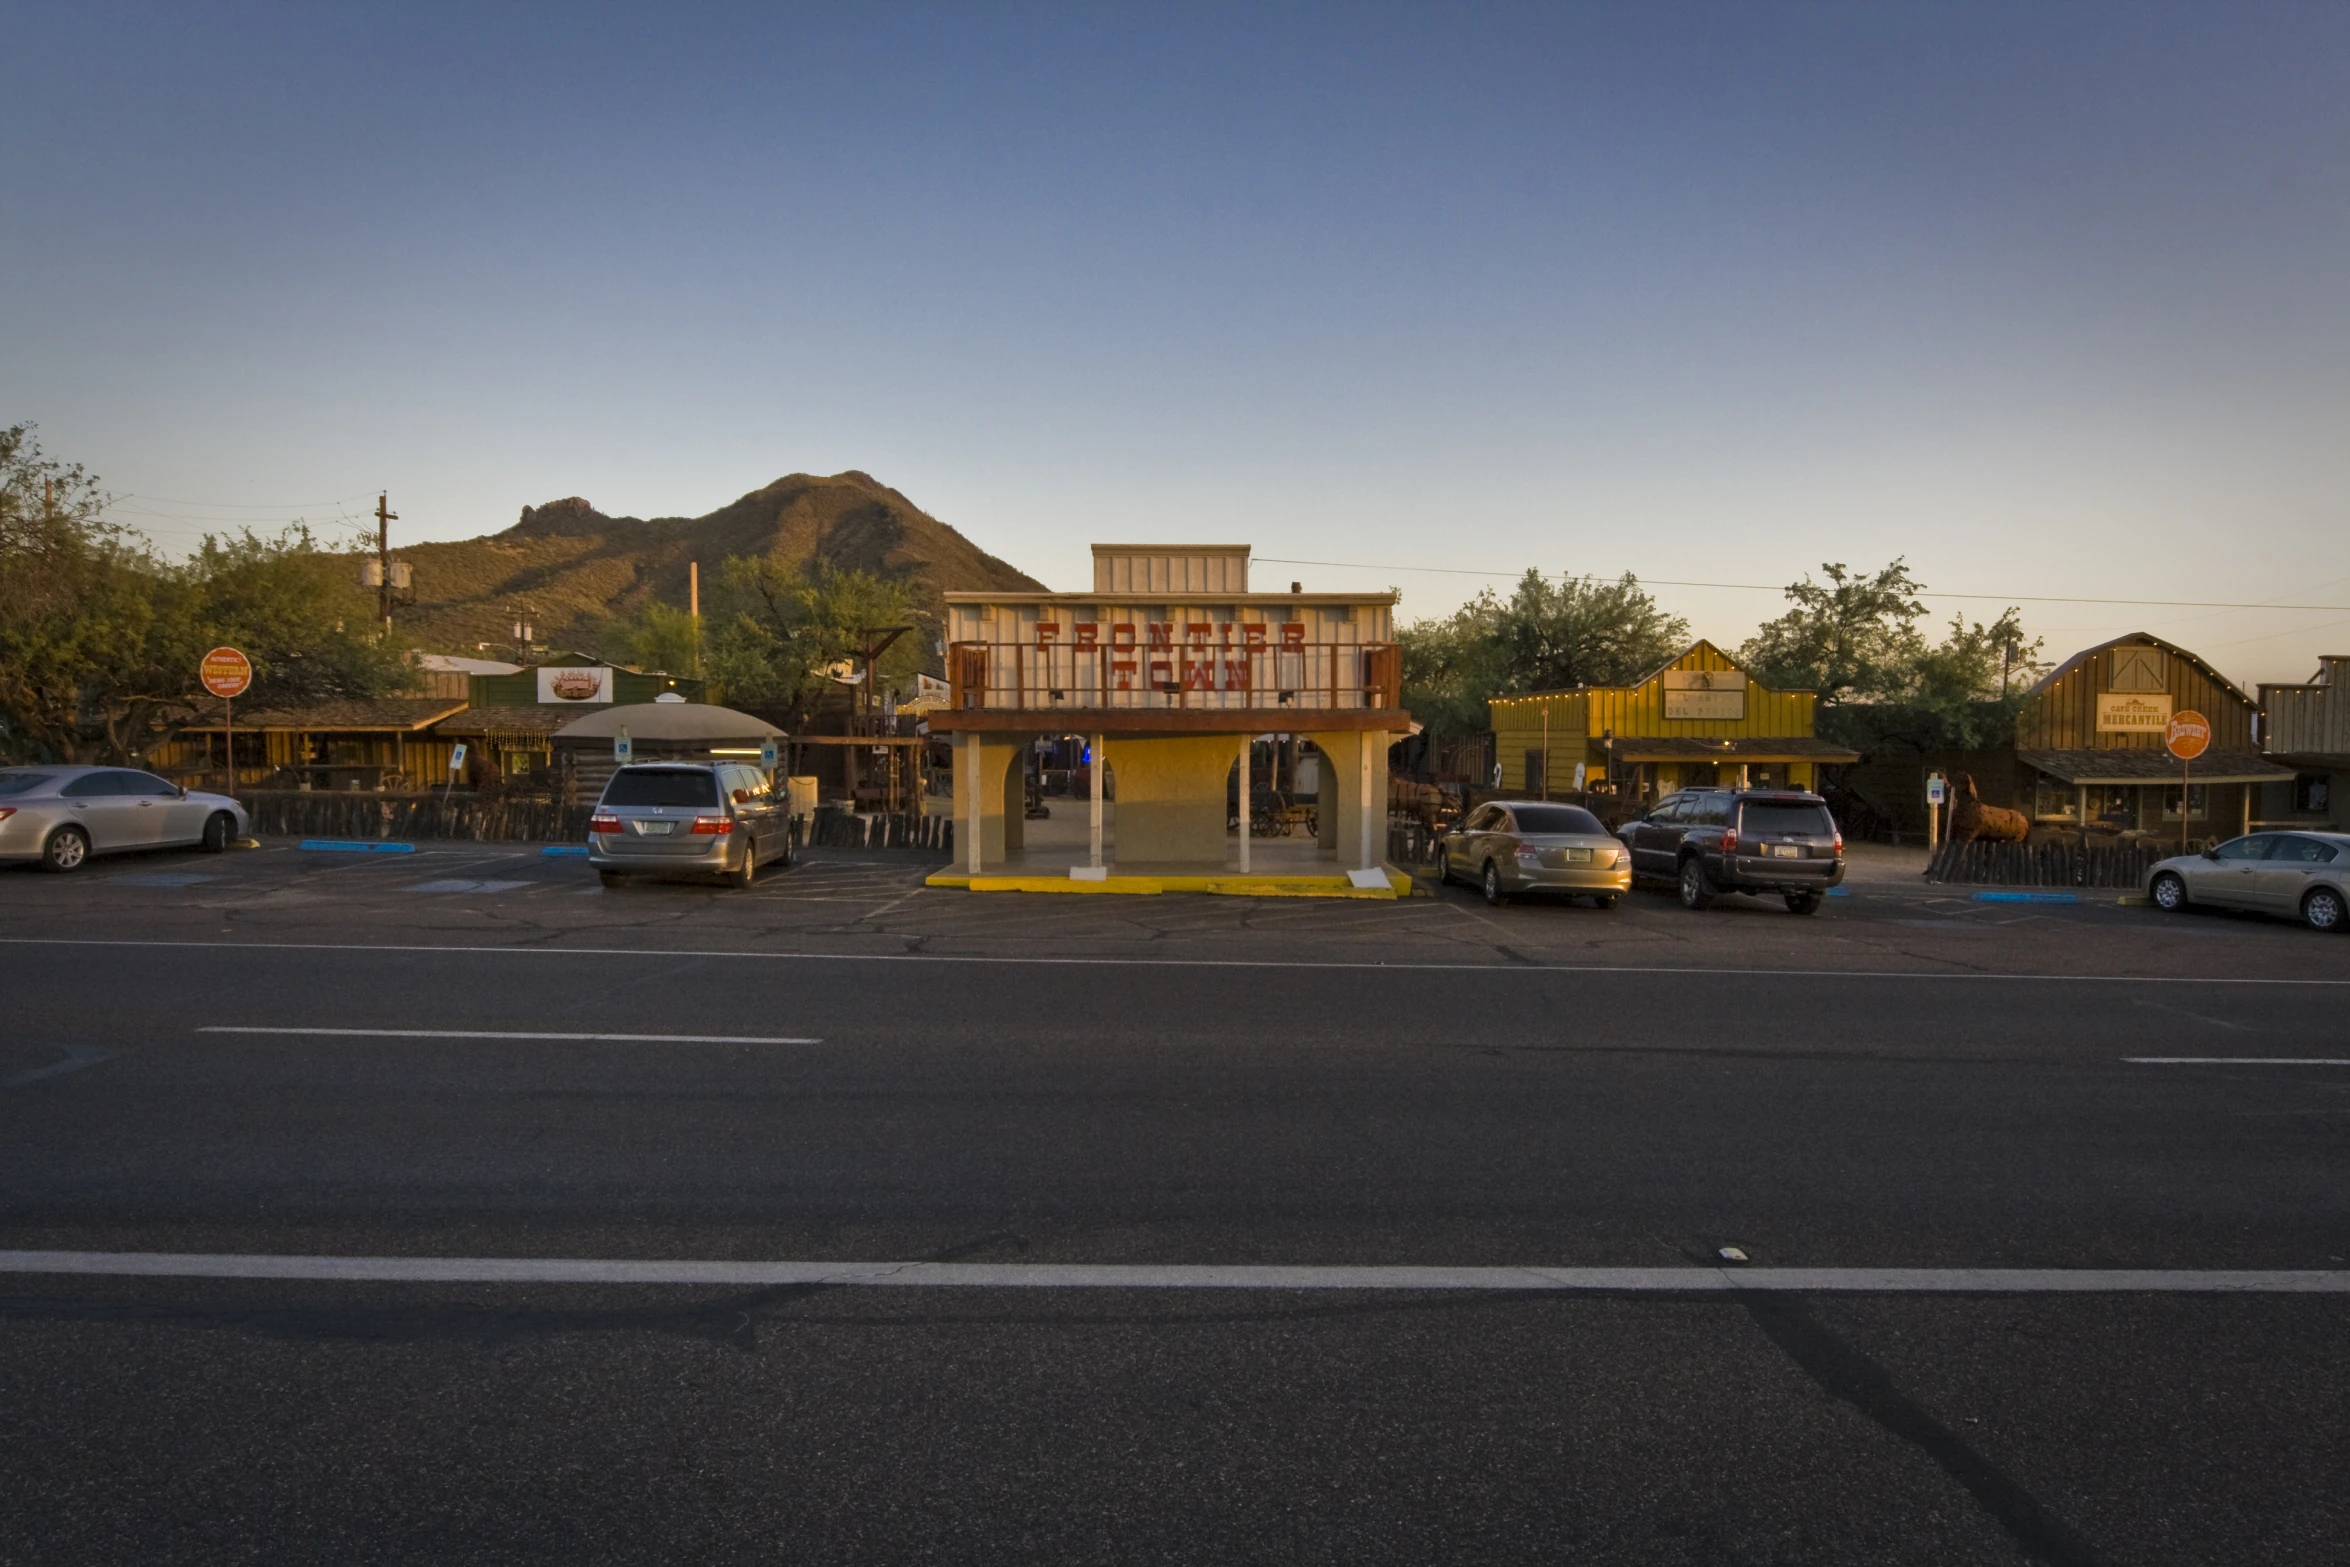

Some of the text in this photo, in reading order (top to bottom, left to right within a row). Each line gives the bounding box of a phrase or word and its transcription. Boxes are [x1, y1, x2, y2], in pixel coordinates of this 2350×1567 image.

[1036, 623, 1306, 653] FRONTIER
[203, 664, 249, 676] WESTERN
[1111, 661, 1249, 690] TOWN
[2110, 705, 2160, 713] CAVE CREEK
[2102, 714, 2168, 726] MERCANTILE
